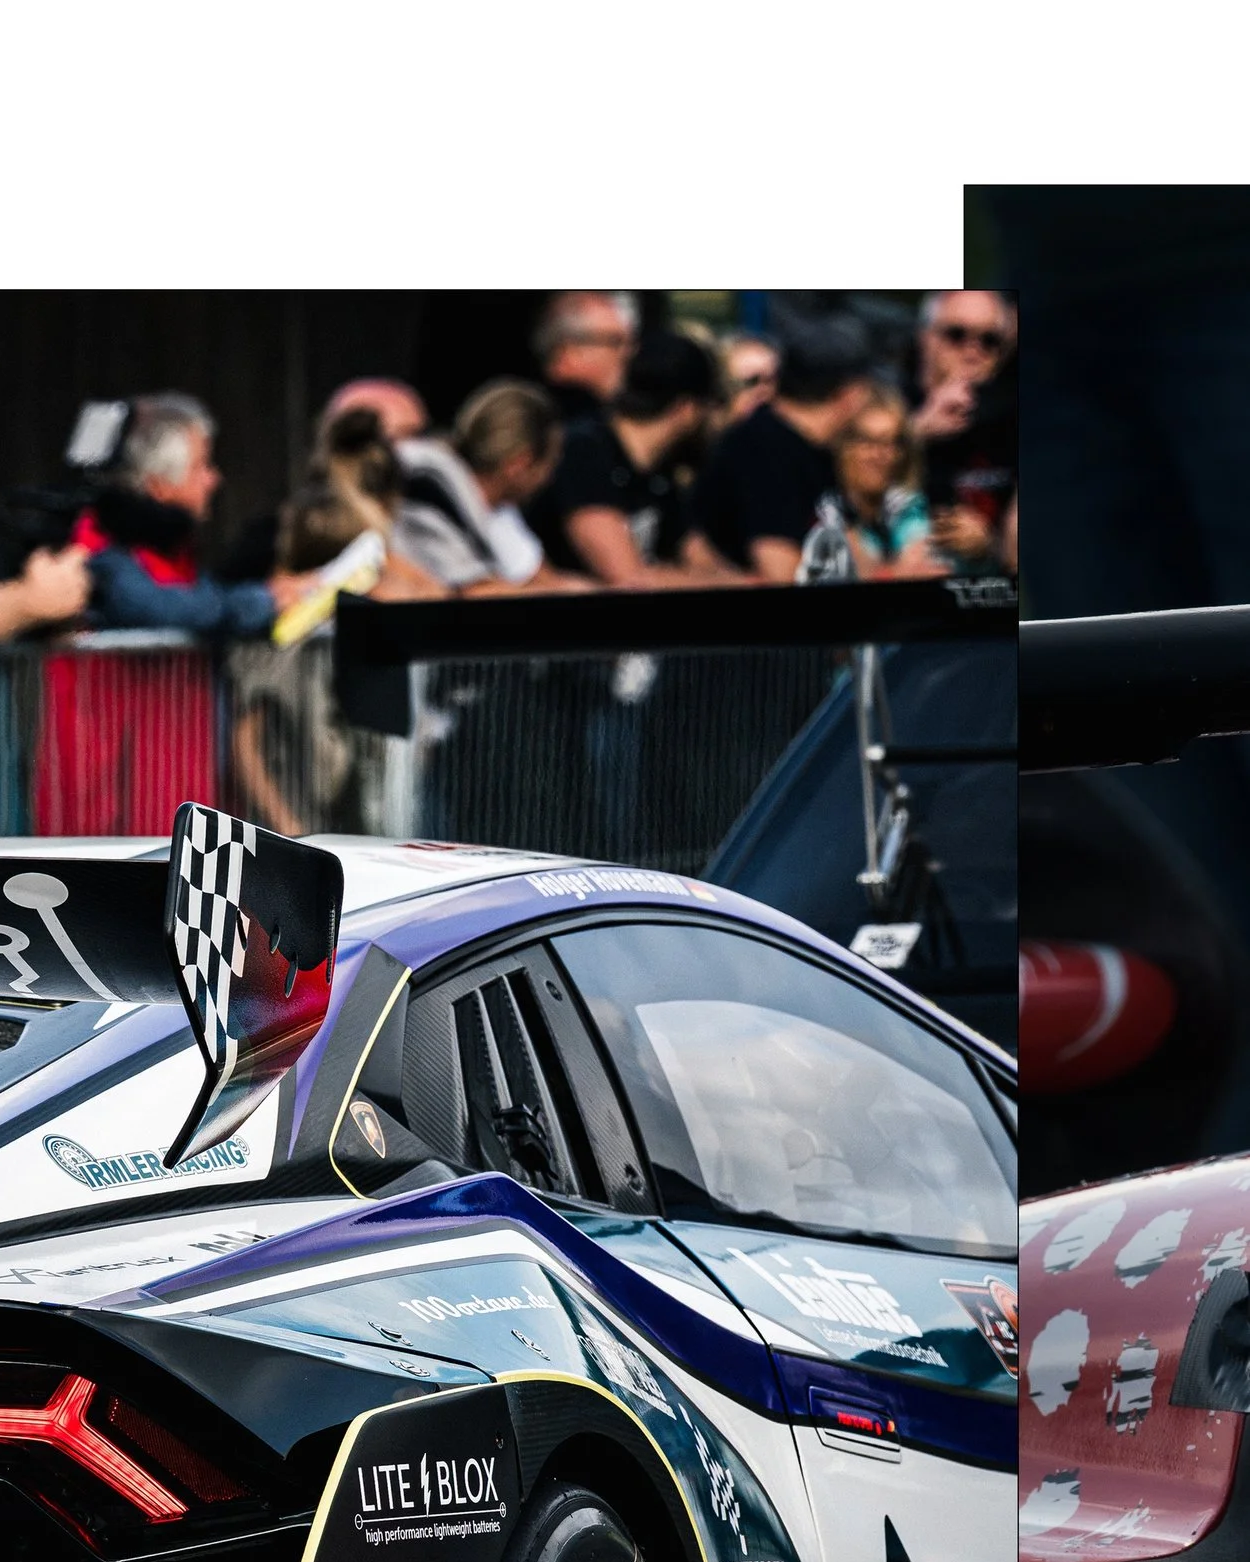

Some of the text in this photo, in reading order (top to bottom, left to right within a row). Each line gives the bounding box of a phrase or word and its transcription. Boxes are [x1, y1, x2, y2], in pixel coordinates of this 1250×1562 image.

[524, 868, 690, 901] Holger Hovemann
[77, 1153, 168, 1188] IRMLER
[357, 1457, 499, 1512] LITE BLOX
[365, 1519, 501, 1546] high performance lightweight batteries
